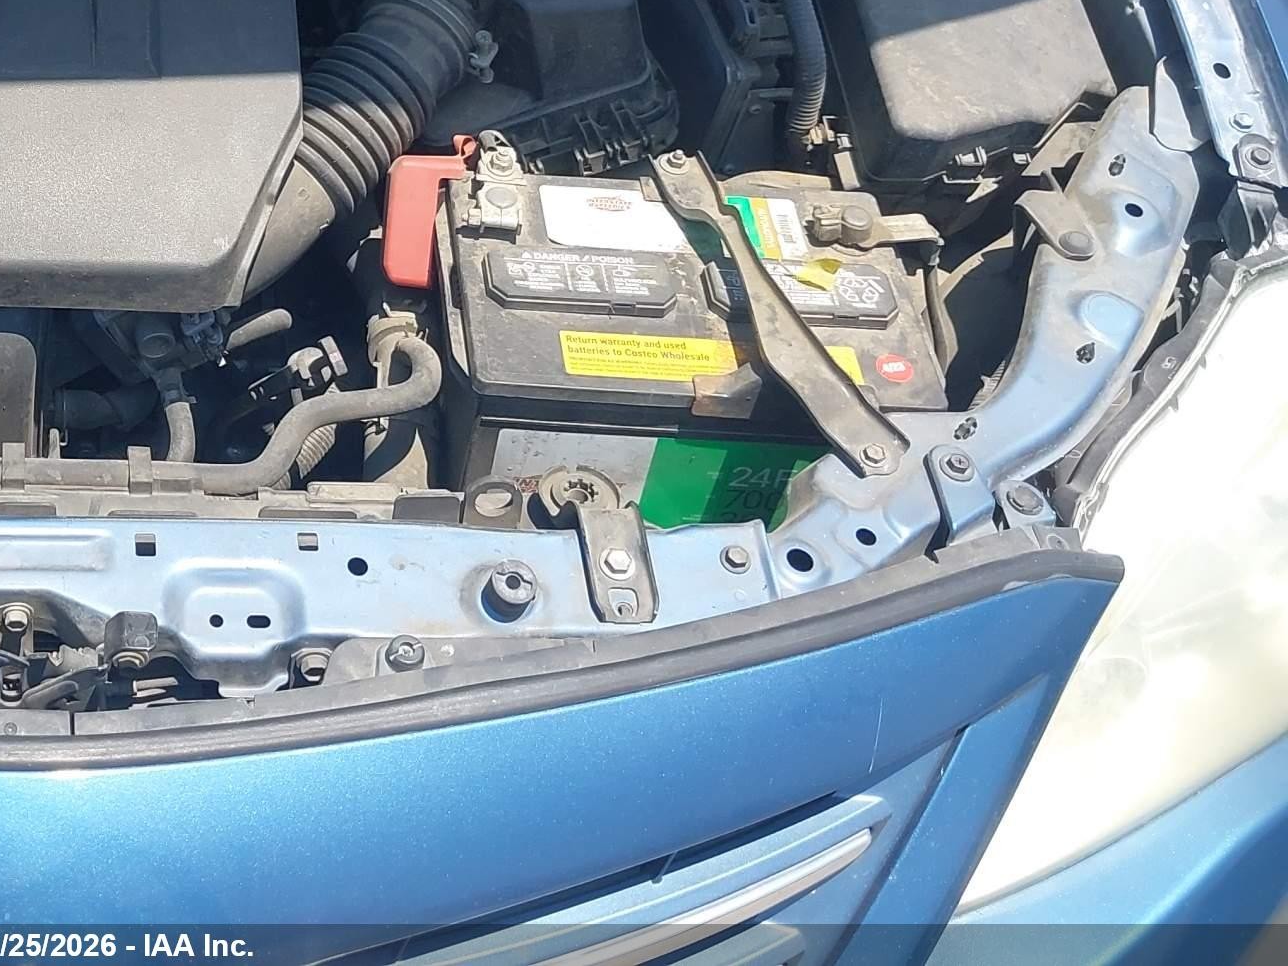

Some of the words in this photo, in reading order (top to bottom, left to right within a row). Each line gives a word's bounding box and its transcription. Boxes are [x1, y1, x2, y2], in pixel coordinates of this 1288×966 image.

[533, 252, 580, 262] DANGER
[591, 256, 634, 264] POISON
[566, 334, 598, 345] Return
[600, 339, 641, 349] warranty
[643, 340, 661, 349] and
[663, 341, 687, 350] used
[567, 344, 610, 356] batteries
[612, 348, 622, 356] to
[624, 349, 658, 359] Costco
[660, 351, 710, 362] Wholesale
[728, 466, 799, 488] 24F
